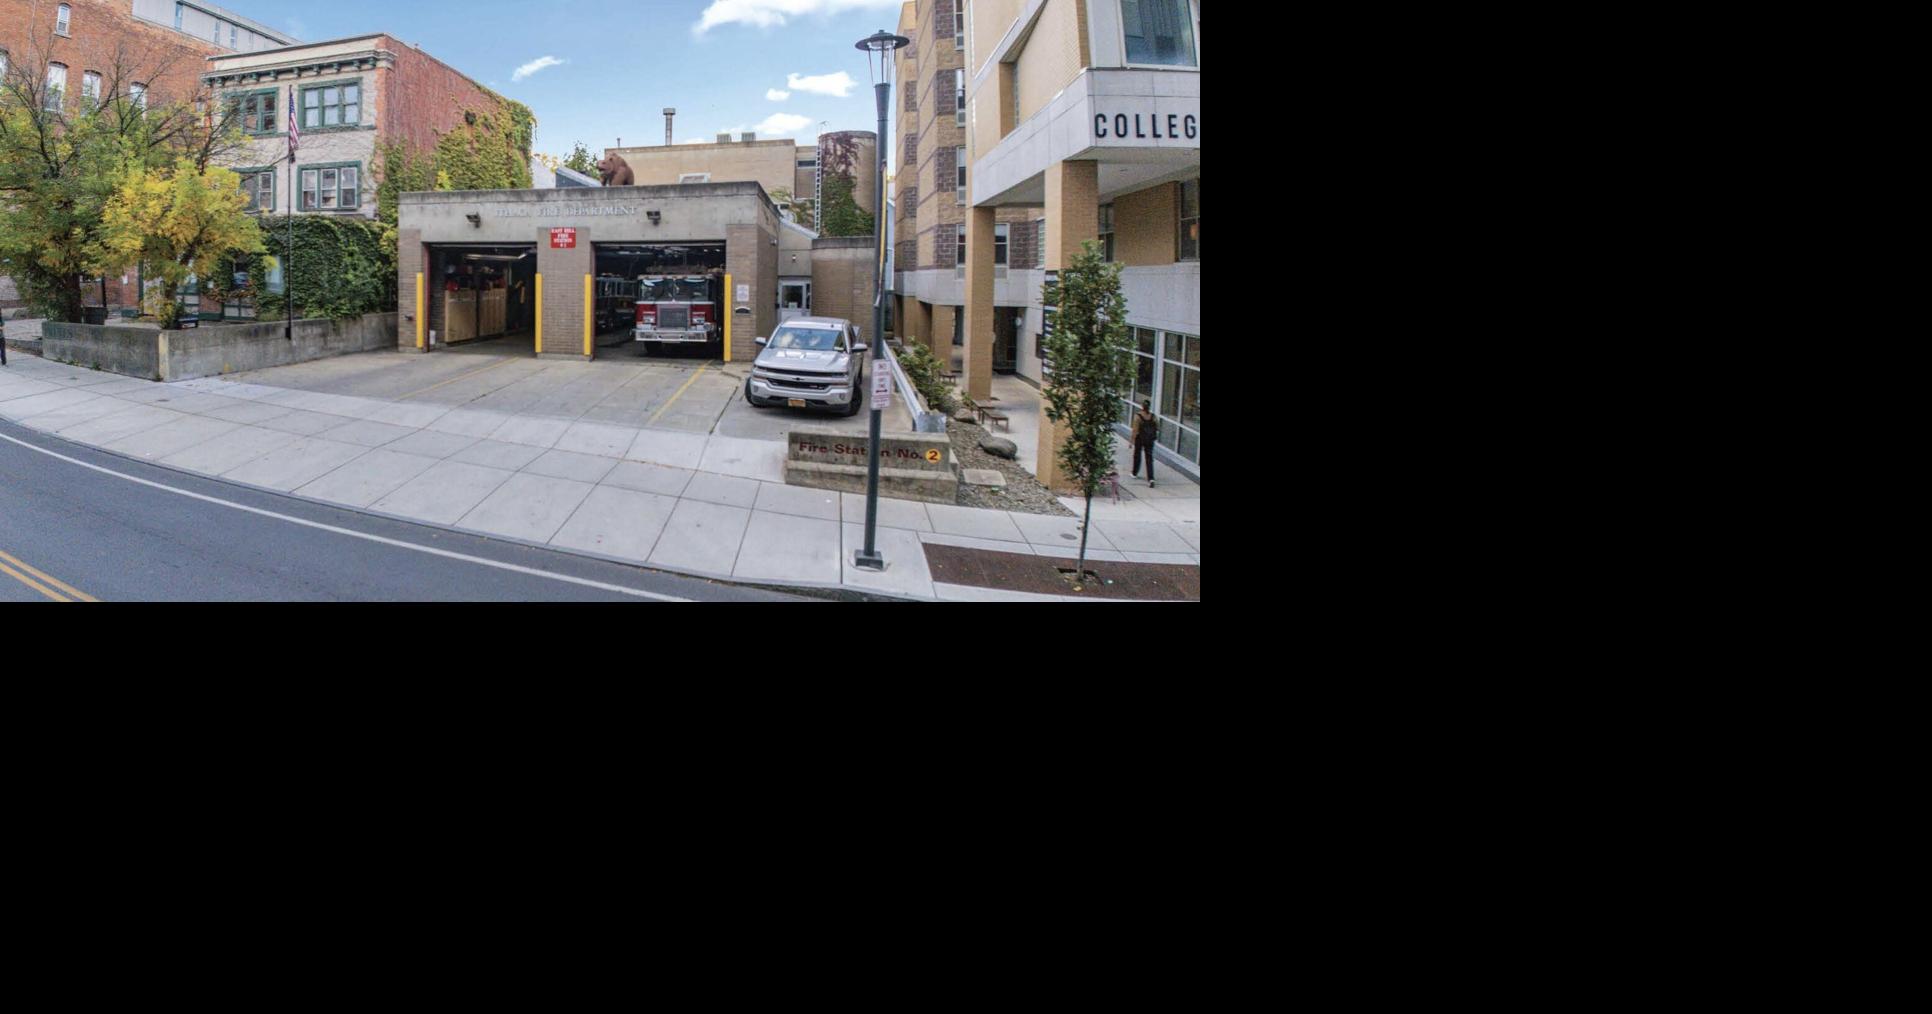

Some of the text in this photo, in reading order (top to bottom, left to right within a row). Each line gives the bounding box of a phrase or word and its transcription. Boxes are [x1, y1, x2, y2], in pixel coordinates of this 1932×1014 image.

[1094, 113, 1197, 139] COLLEG
[537, 207, 561, 217] FIRE
[566, 206, 637, 216] DEPARTMENT
[799, 441, 938, 461] Fire Statn No. 2
